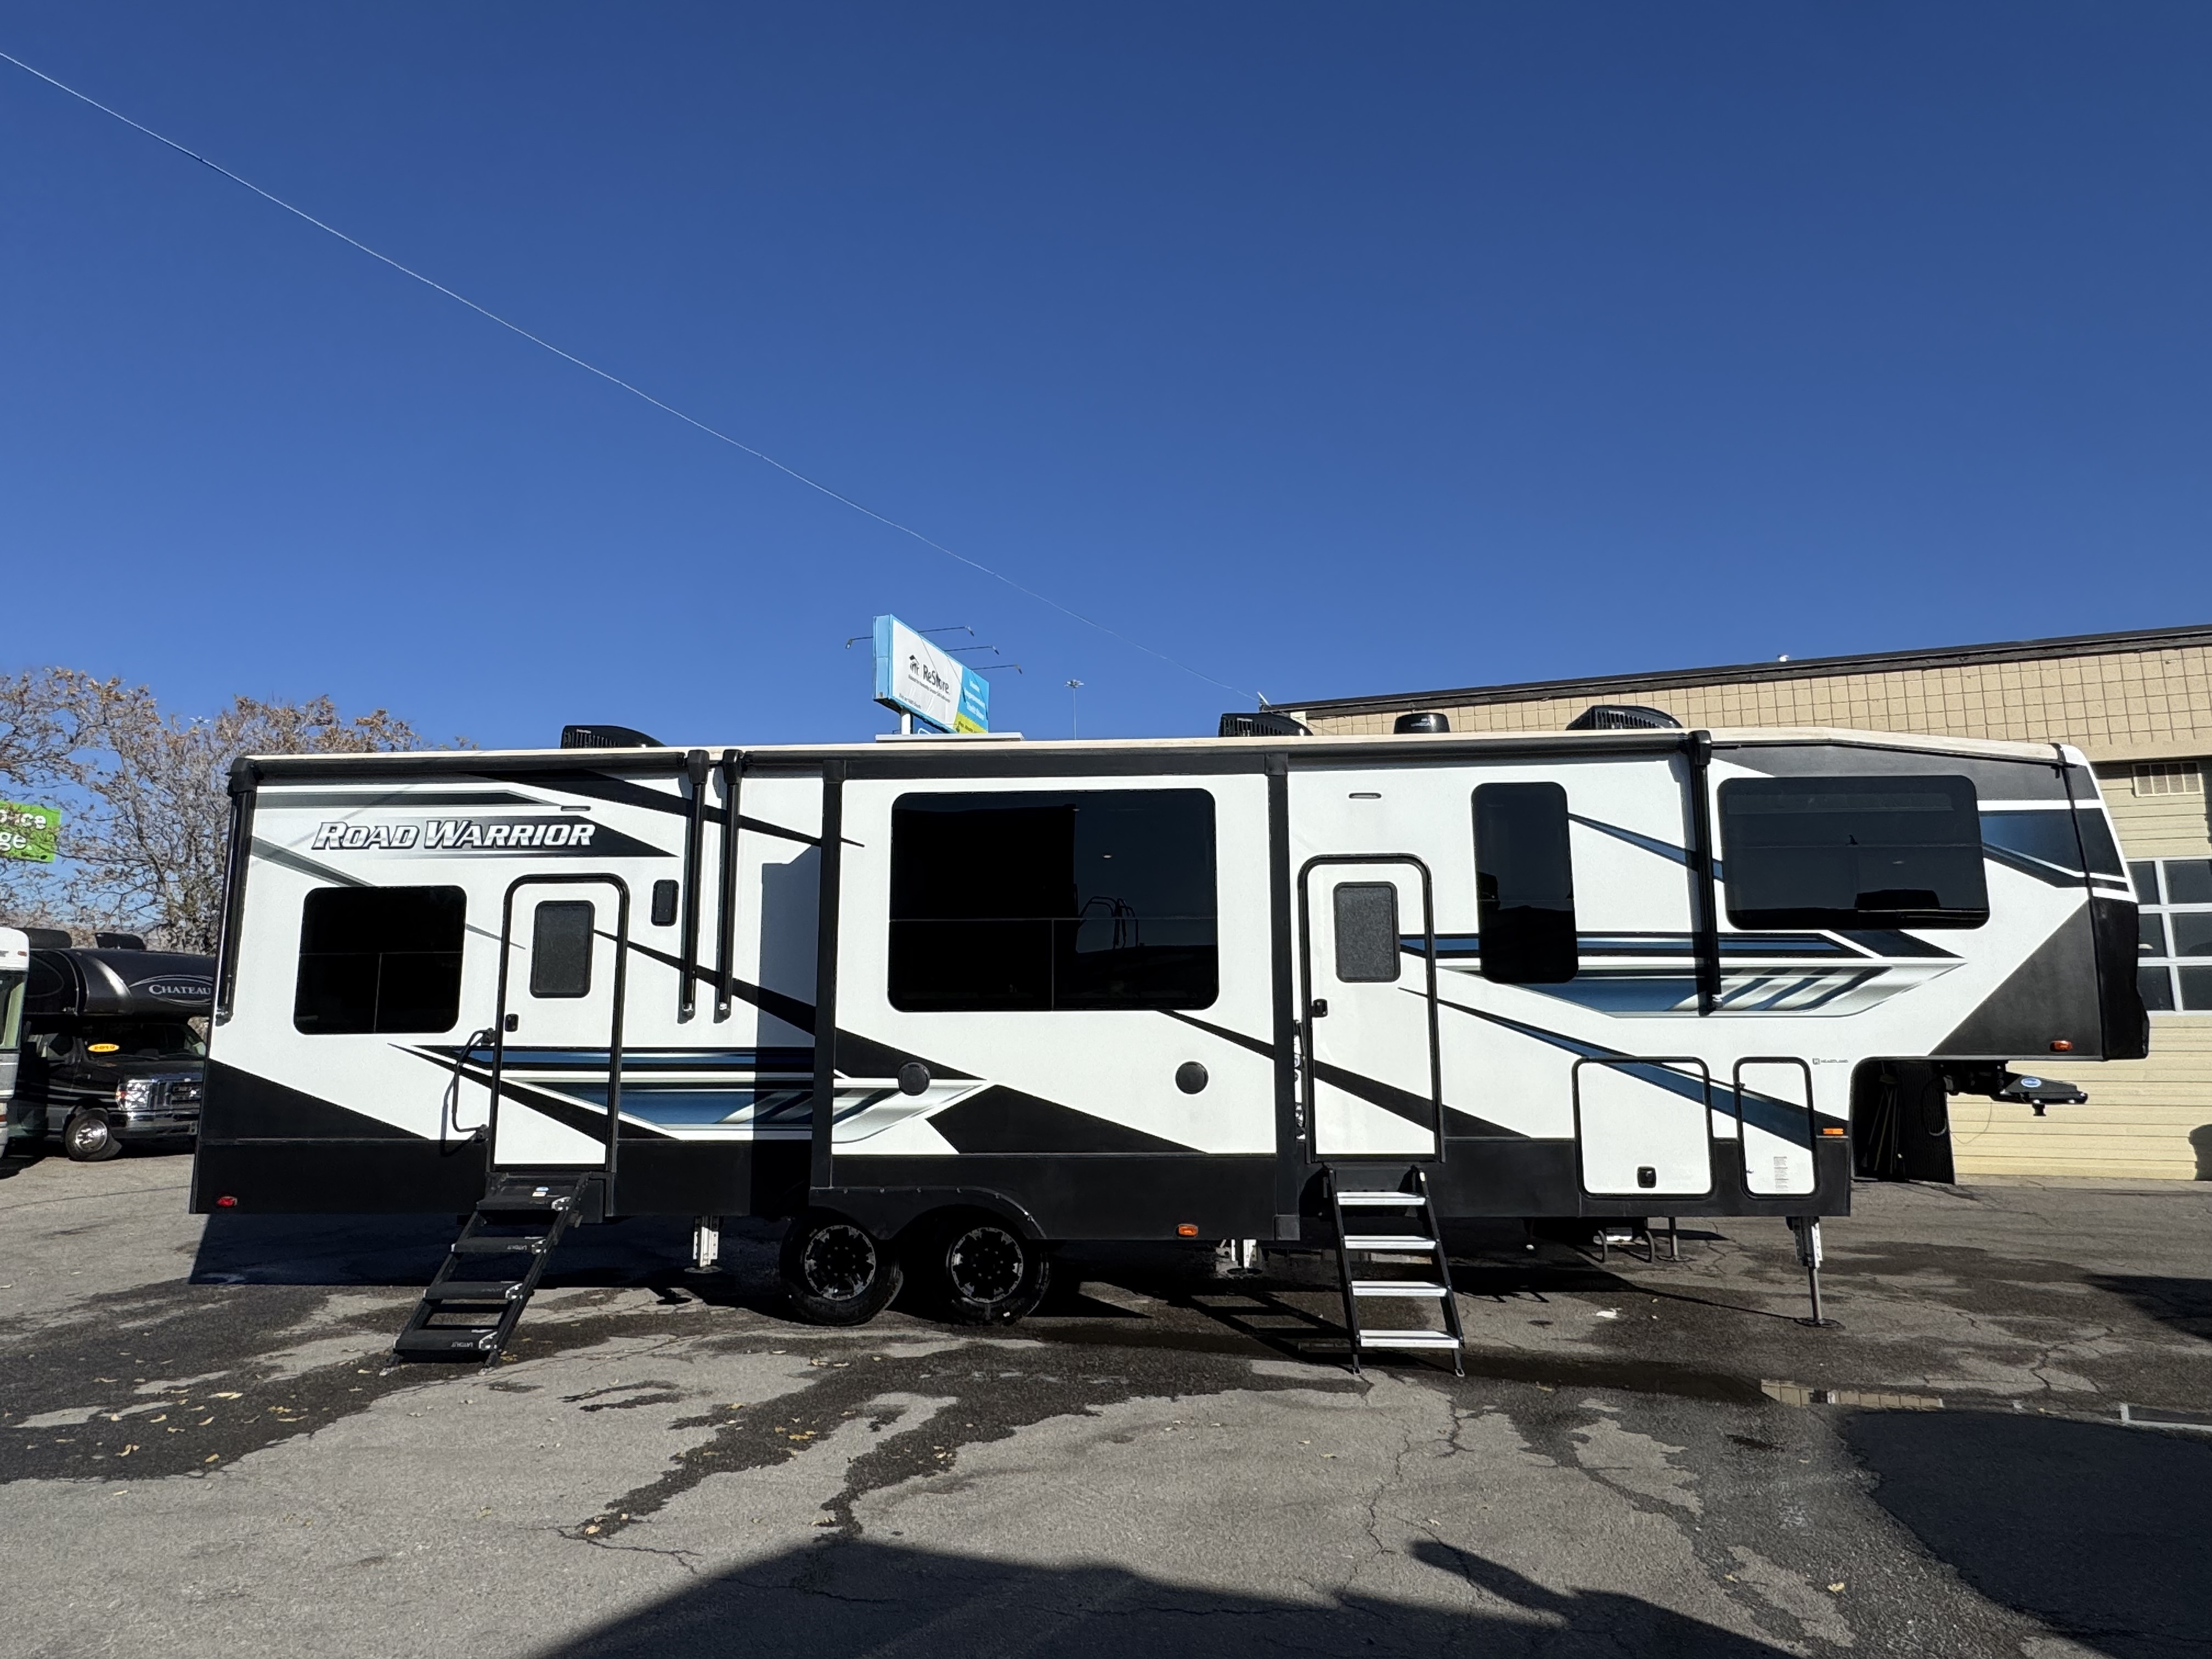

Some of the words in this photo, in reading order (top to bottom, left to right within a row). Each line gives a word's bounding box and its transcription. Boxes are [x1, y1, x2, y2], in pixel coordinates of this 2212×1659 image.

[923, 664, 950, 695] ReStore
[311, 821, 420, 850] ROAD
[424, 820, 596, 848] WARRIOR
[148, 984, 211, 995] CHATEAU
